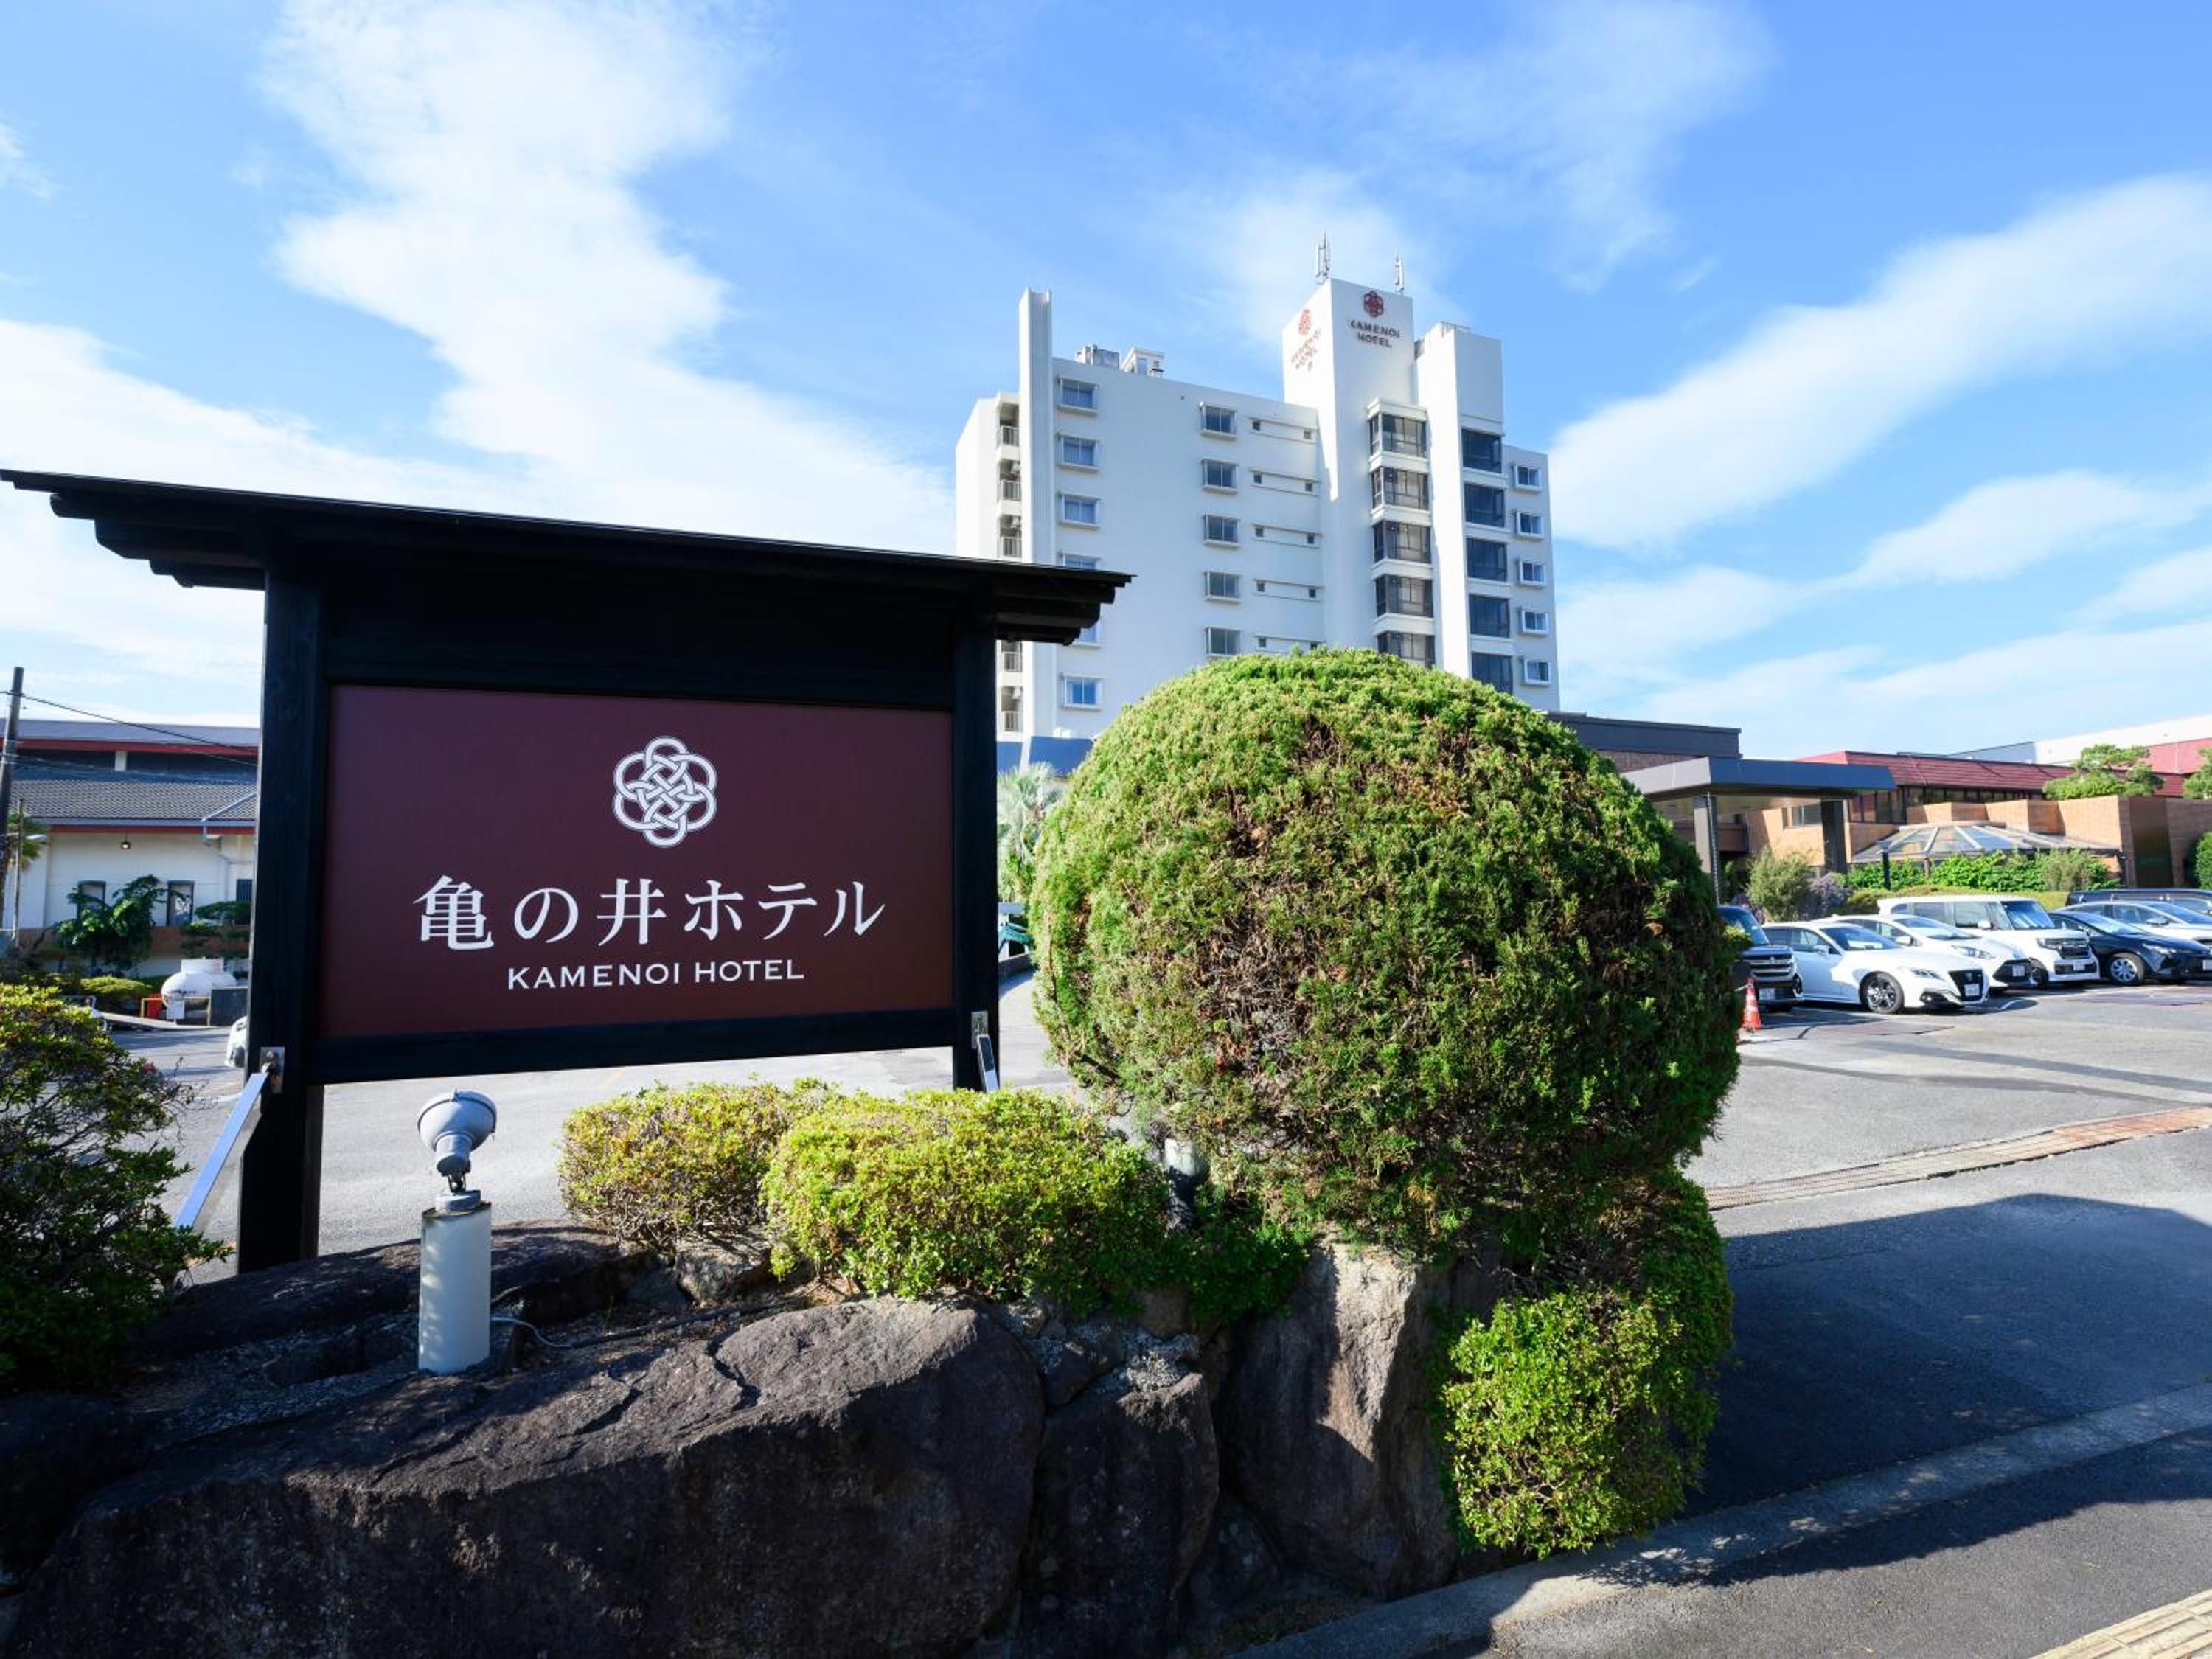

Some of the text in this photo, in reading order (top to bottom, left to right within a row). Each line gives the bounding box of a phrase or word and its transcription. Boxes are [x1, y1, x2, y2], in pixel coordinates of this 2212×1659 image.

[1357, 331, 1393, 348] HOTEL
[413, 874, 885, 950] 亀の井ホテル
[508, 959, 804, 990] KAMENOI HOTEL
